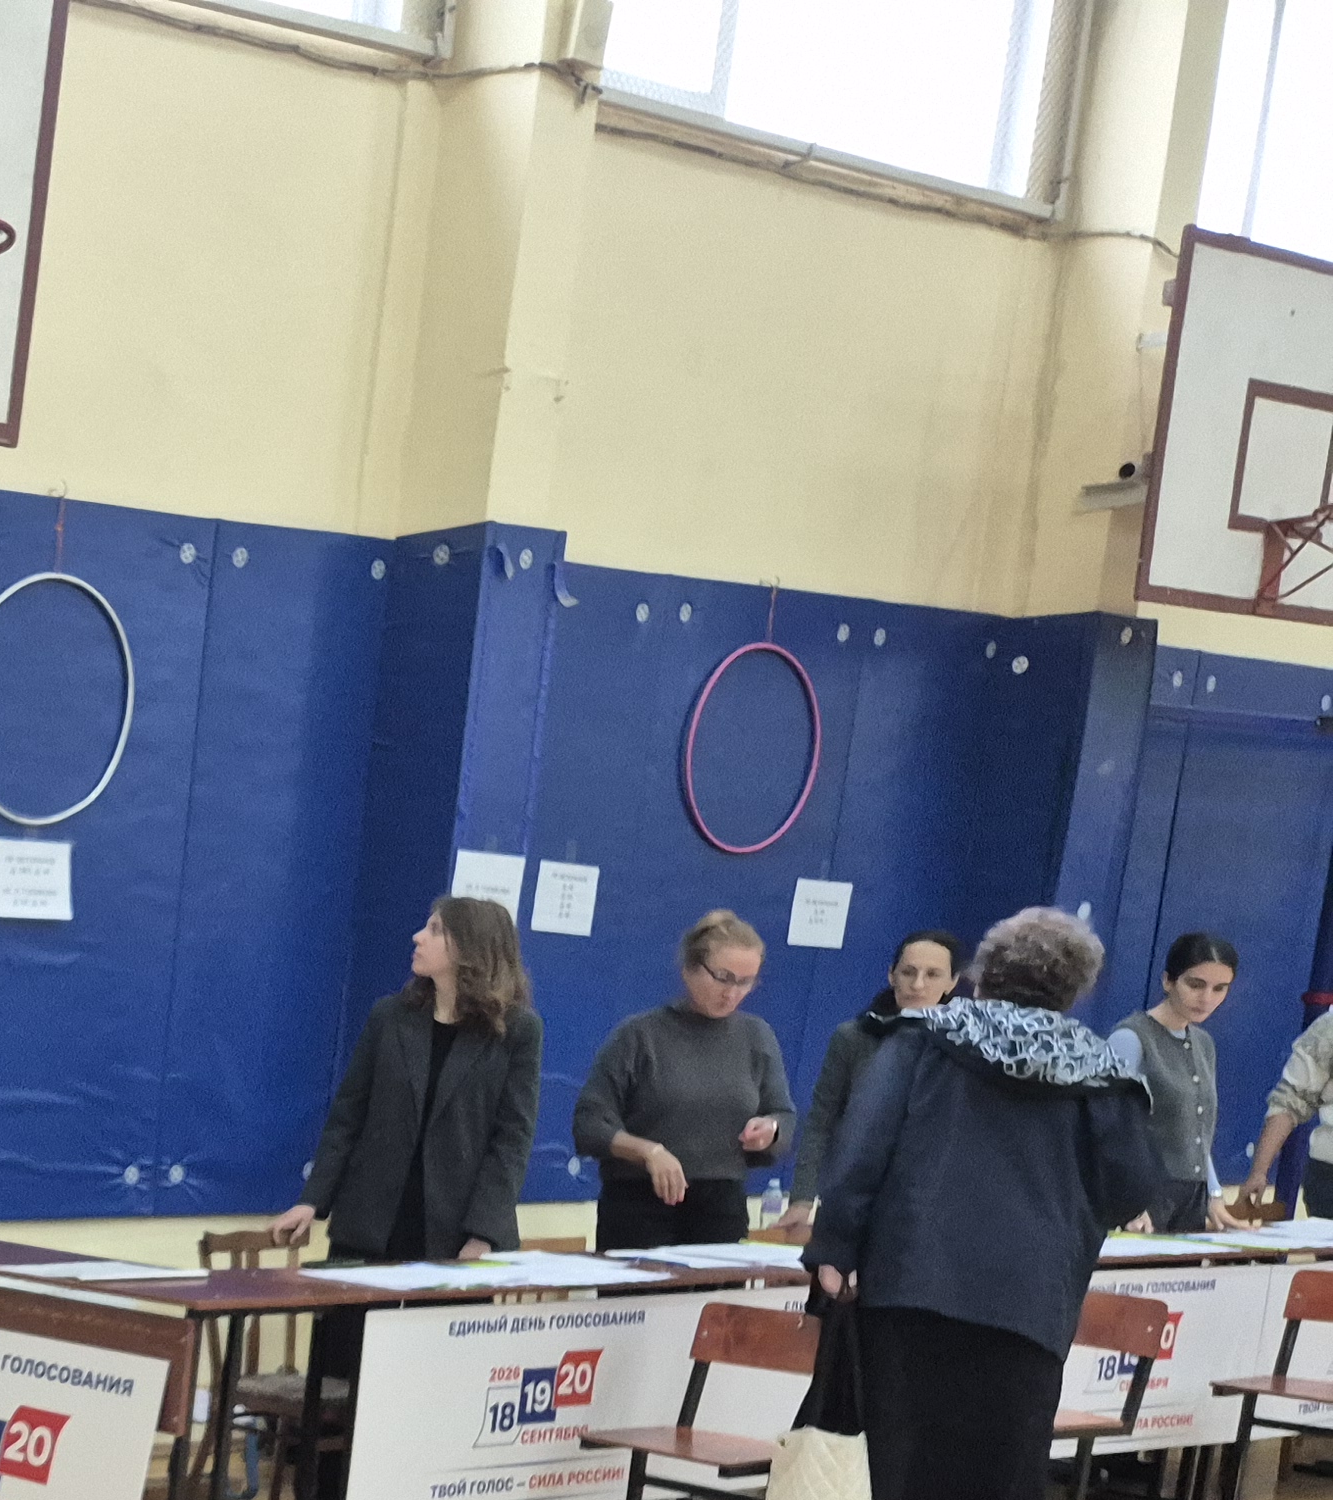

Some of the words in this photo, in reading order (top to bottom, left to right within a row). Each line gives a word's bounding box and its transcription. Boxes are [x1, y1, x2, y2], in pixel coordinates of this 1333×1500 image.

[1146, 1279, 1216, 1293] ГОЛОСОВАНИЯ
[449, 1315, 507, 1337] ЕДИНЫЙ
[510, 1317, 545, 1334] ДЕНЬ
[549, 1310, 645, 1330] ГОЛОСОВАНИЯ
[1098, 1355, 1117, 1381] 18
[1160, 1322, 1173, 1350] 0
[1, 1354, 134, 1397] ГОЛОСОВАНИЯ
[489, 1366, 520, 1382] 2026
[489, 1402, 515, 1433] 18
[524, 1381, 551, 1413] 19
[557, 1362, 592, 1395] 20
[4, 1421, 52, 1467] 20
[430, 1479, 466, 1498] ТВОЙ
[470, 1477, 514, 1495] ГОЛОС
[528, 1472, 564, 1489] СИЛА
[567, 1466, 624, 1485] РОССИИ!
